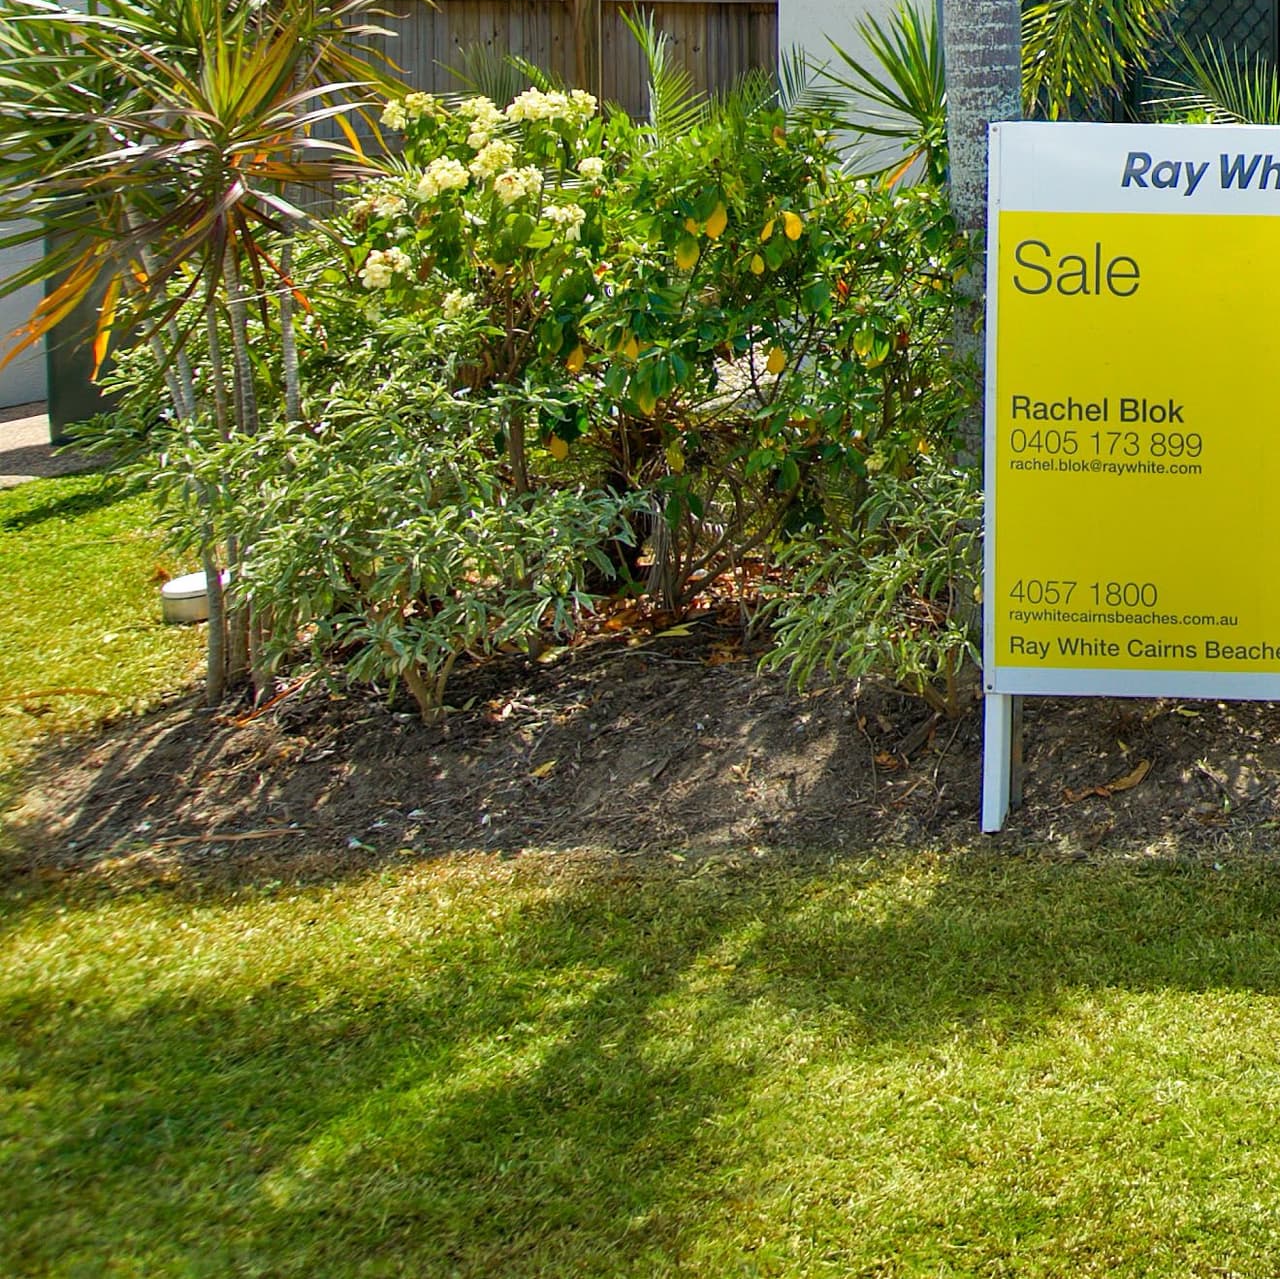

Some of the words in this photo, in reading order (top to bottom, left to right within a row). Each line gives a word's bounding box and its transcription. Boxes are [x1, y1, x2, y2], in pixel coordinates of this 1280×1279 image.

[1121, 152, 1209, 196] Ray
[1012, 240, 1141, 297] Sale
[1011, 395, 1108, 423] Rachel
[1119, 398, 1185, 424] Blok
[1010, 429, 1078, 455] 0405
[1090, 431, 1140, 457] 173
[1150, 433, 1203, 458] 899
[1010, 458, 1202, 476] rachel.blok@raywhite.com
[1009, 580, 1077, 605] 4057
[1090, 582, 1158, 607] 1800
[1009, 609, 1239, 627] raywhitecairnsbeaches.com.au
[1010, 636, 1050, 659] Ray
[1057, 638, 1120, 658] White
[1126, 639, 1198, 659] Cairns
